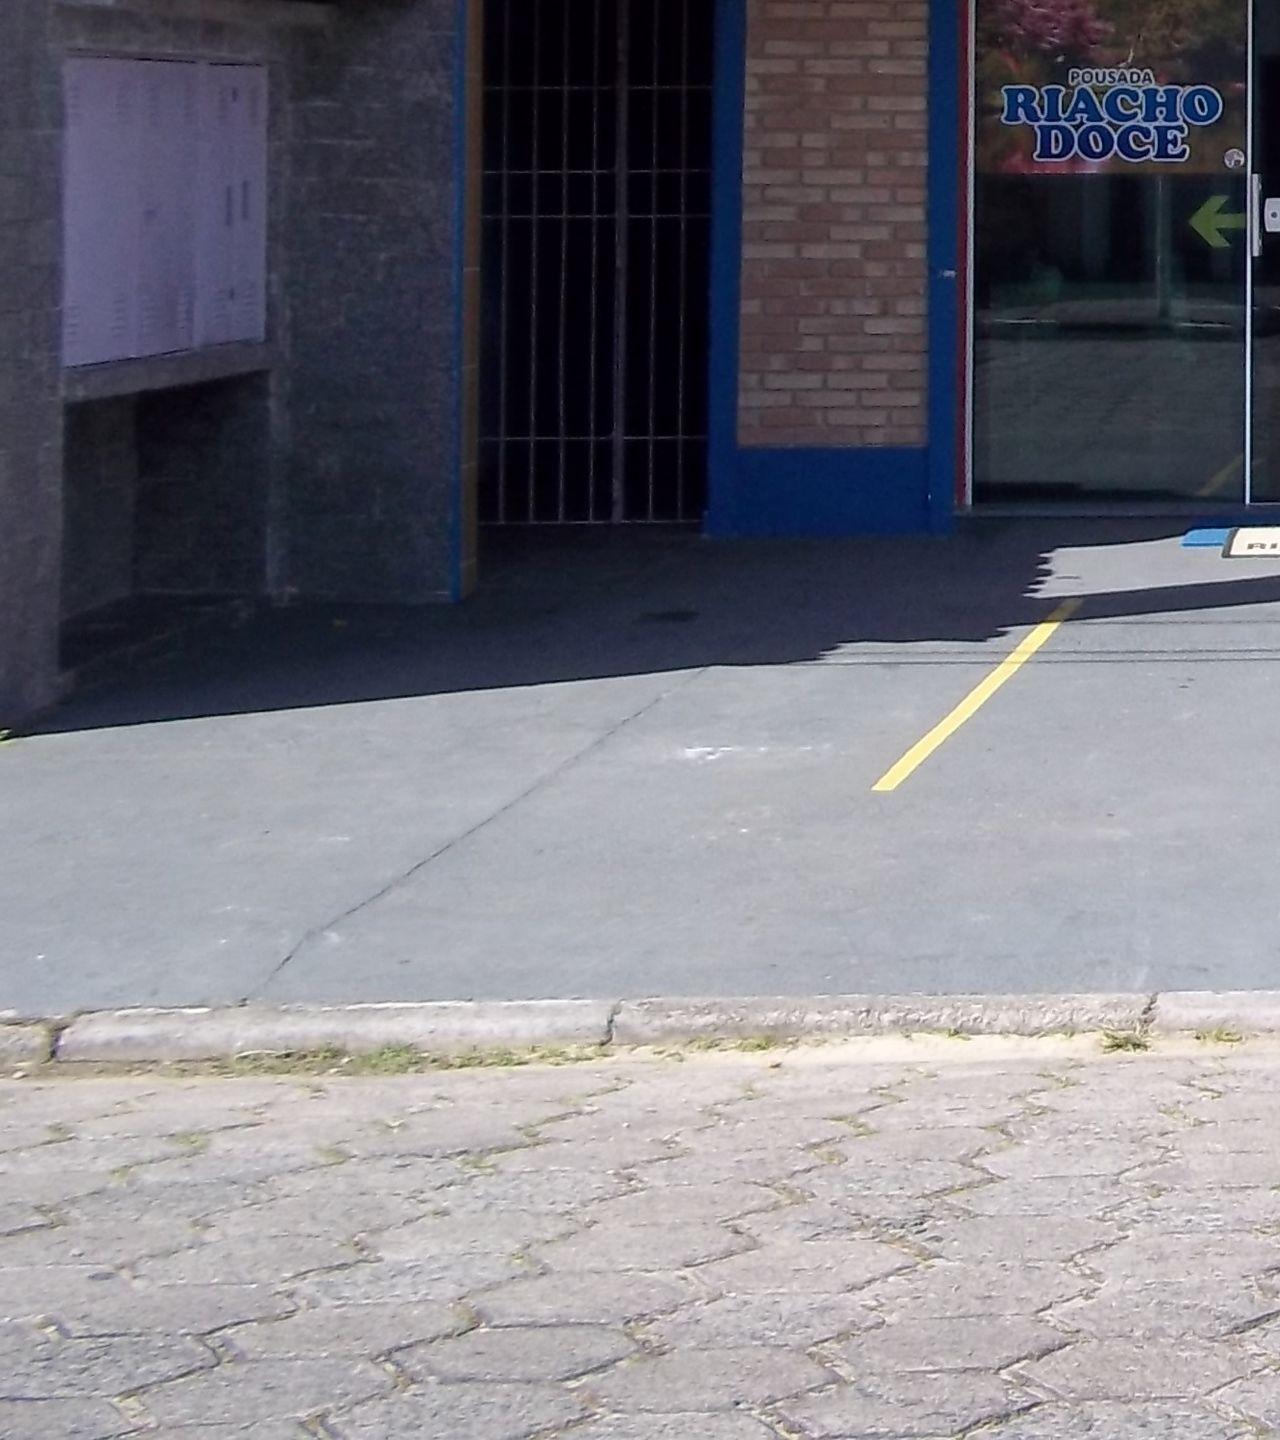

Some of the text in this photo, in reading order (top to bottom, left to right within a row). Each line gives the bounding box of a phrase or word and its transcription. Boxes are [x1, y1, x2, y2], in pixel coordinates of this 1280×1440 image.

[1068, 68, 1155, 86] POUSADA
[1001, 85, 1223, 125] RIACHO
[1033, 123, 1190, 162] DOCE
